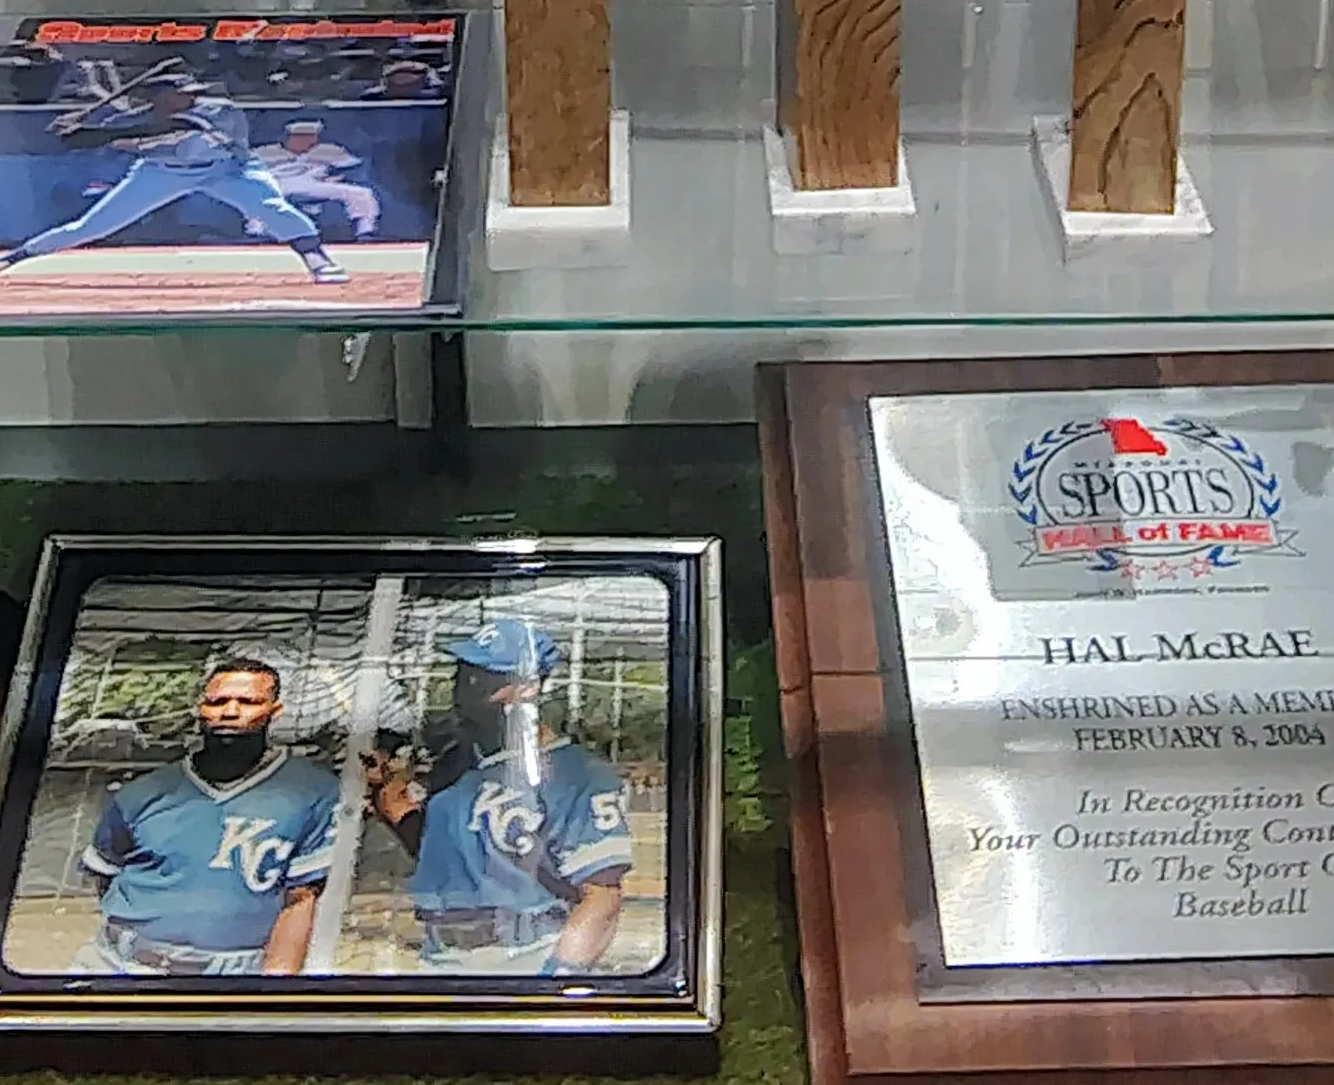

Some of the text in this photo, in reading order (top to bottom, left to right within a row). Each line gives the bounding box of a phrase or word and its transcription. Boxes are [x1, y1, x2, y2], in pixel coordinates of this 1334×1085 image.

[35, 19, 207, 43] Sports
[1057, 467, 1235, 519] SPORTS
[1040, 522, 1273, 552] HALL of FAME
[1041, 629, 1320, 665] HAL McRAE
[1001, 695, 1177, 721] ENSHRINED
[1185, 694, 1218, 718] AS
[1228, 692, 1253, 716] A
[1074, 722, 1327, 753] FEBRUARY 8, 2004
[466, 781, 545, 856] KC
[1077, 788, 1112, 814] In
[1123, 785, 1305, 819] Recognition
[209, 815, 292, 892] KC
[967, 826, 1039, 853] Your
[1052, 821, 1254, 854] Outstanding
[1103, 855, 1142, 884] To
[1152, 853, 1214, 882] The
[1223, 852, 1312, 886] Sport
[1171, 888, 1312, 919] Baseball
